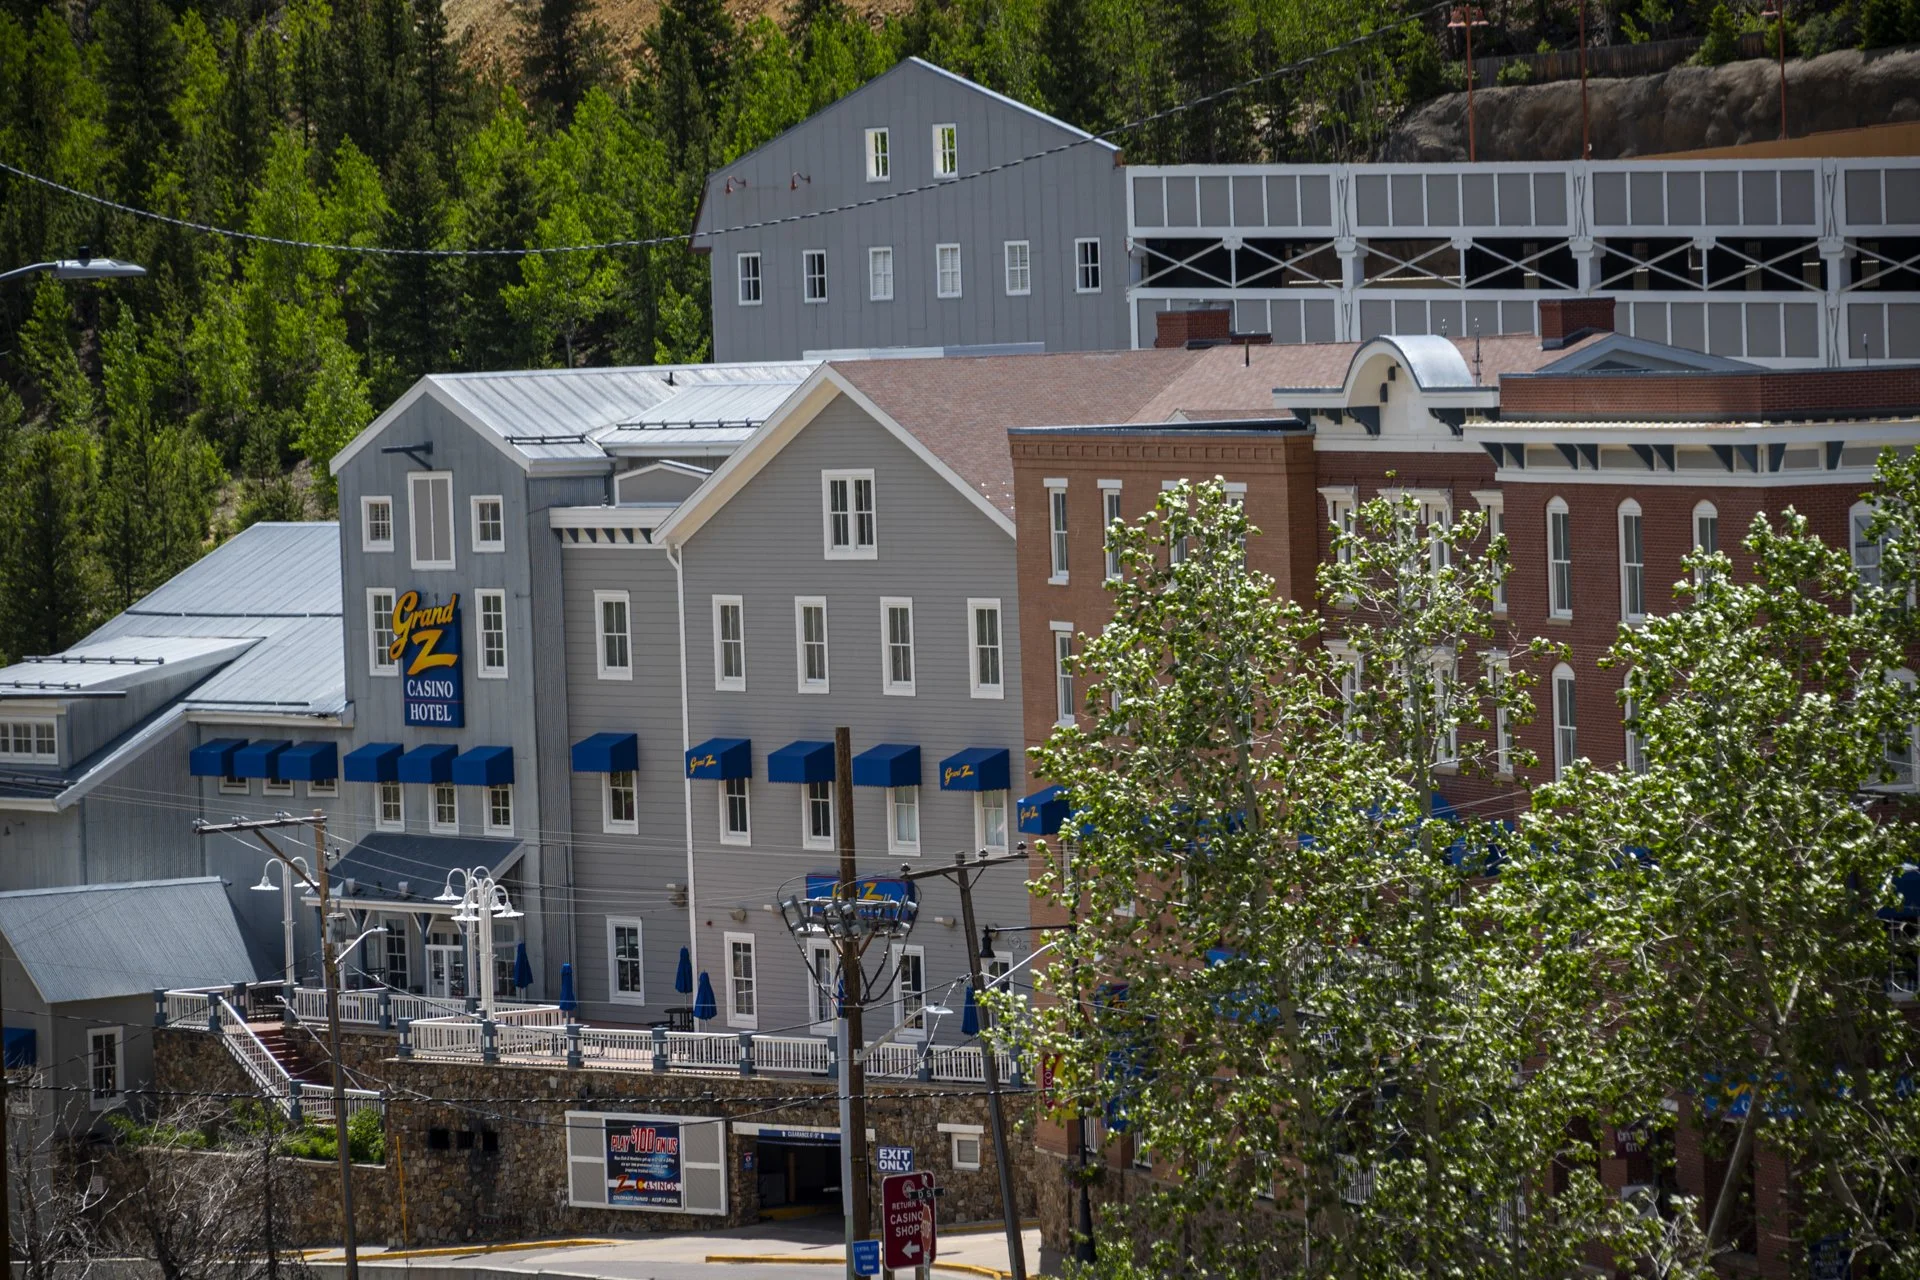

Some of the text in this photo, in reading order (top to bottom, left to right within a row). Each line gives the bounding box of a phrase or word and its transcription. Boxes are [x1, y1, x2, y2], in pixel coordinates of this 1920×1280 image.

[389, 590, 457, 660] Grand
[407, 629, 458, 676] Z
[406, 679, 454, 698] CASINO
[410, 703, 452, 721] HOTEL
[611, 1125, 678, 1155] PLAY $100 ON US
[879, 1148, 910, 1160] EXIT
[878, 1160, 911, 1171] ONLY
[615, 1175, 635, 1194] Z
[891, 1200, 917, 1210] RETURN
[890, 1211, 924, 1225] CASINO
